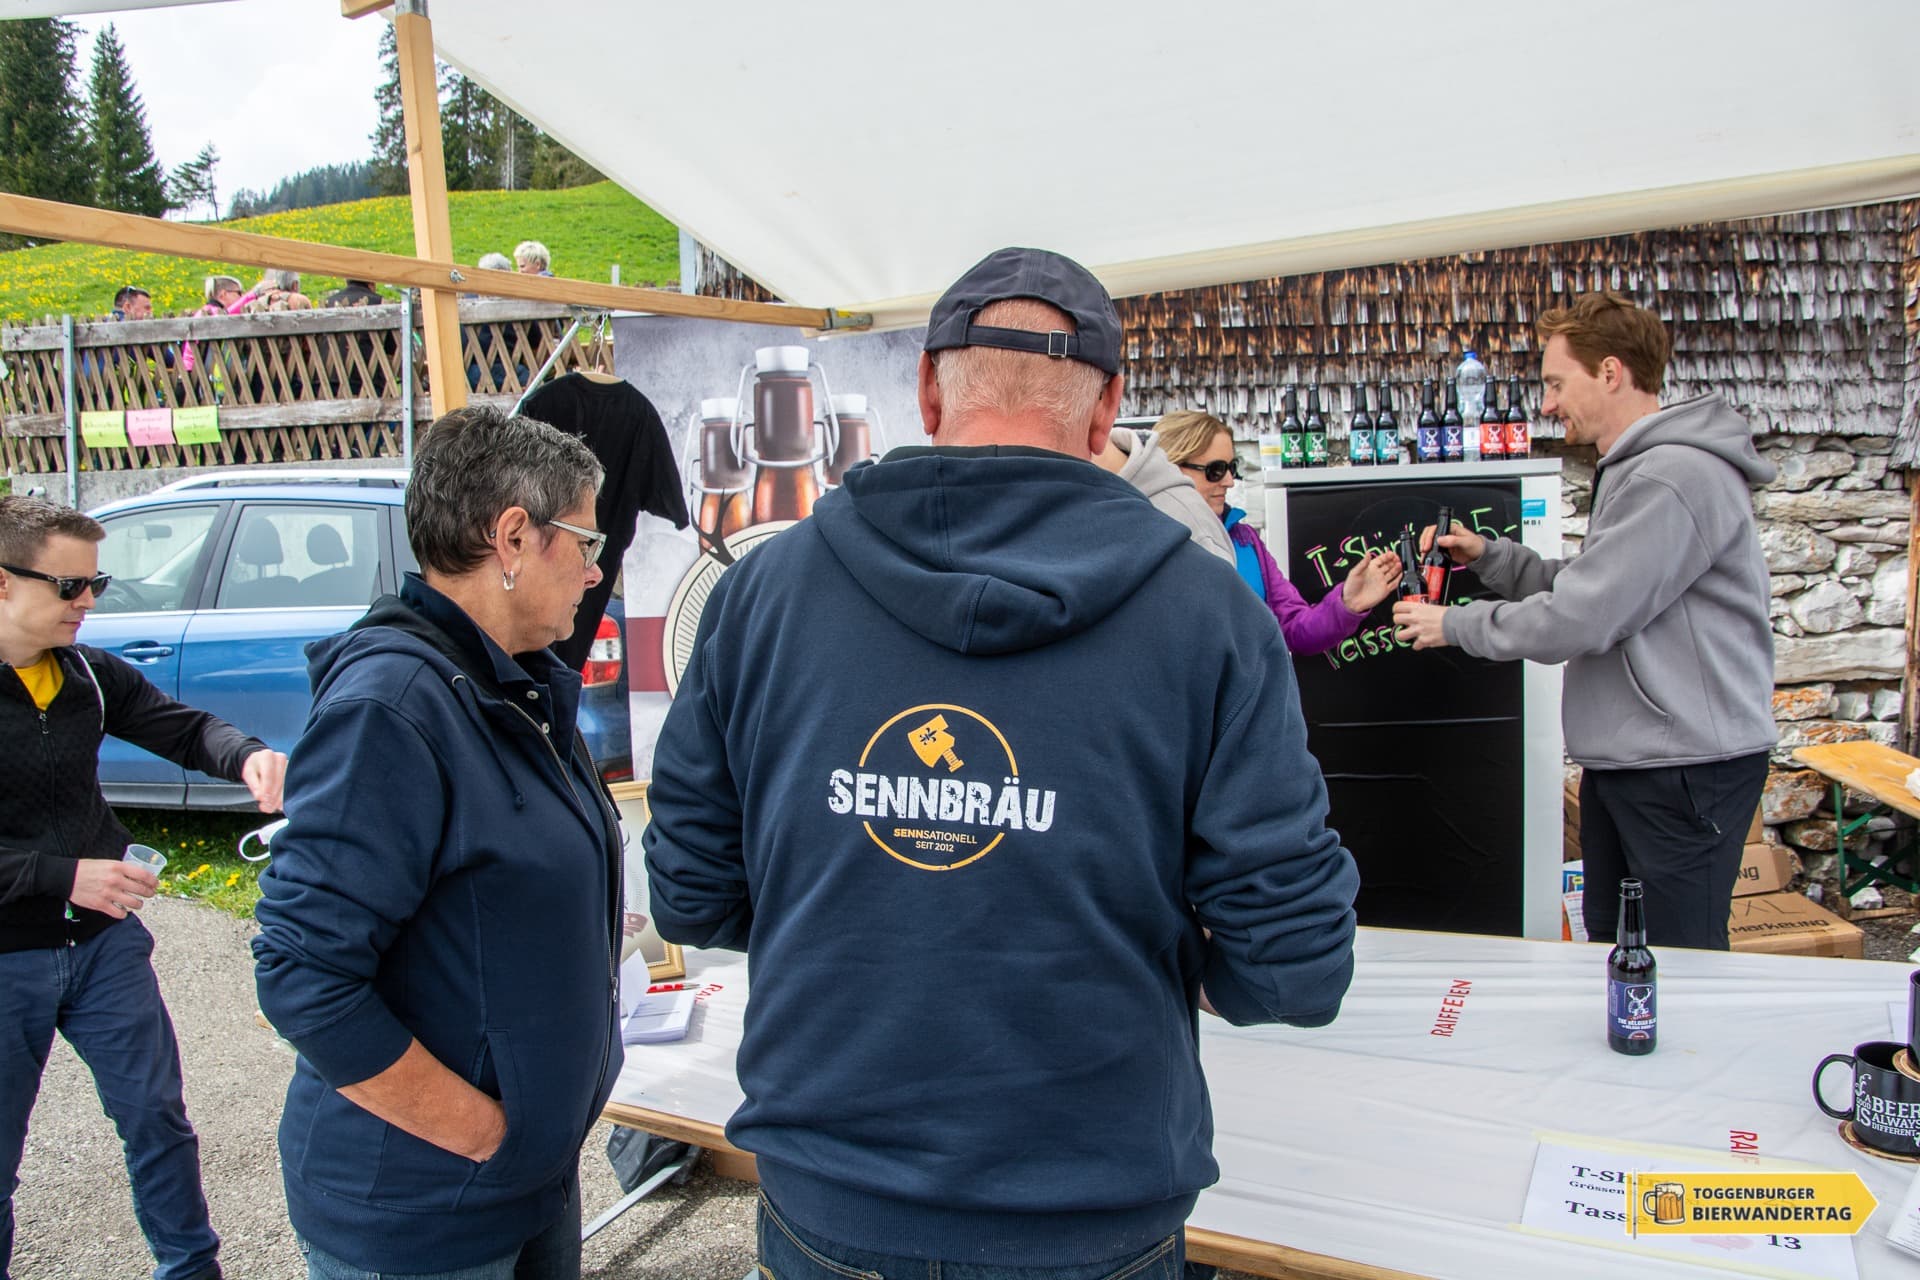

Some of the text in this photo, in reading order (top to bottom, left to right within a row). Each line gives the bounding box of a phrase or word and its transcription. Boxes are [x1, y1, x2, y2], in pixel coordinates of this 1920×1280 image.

[827, 768, 1057, 832] SENNBRÄU
[893, 828, 978, 844] SENNSATIONELL
[915, 841, 955, 853] SEIT 2012
[1856, 1104, 1872, 1127] IS
[1872, 1122, 1917, 1137] DIFFERENT
[1765, 1234, 1802, 1250] 13
